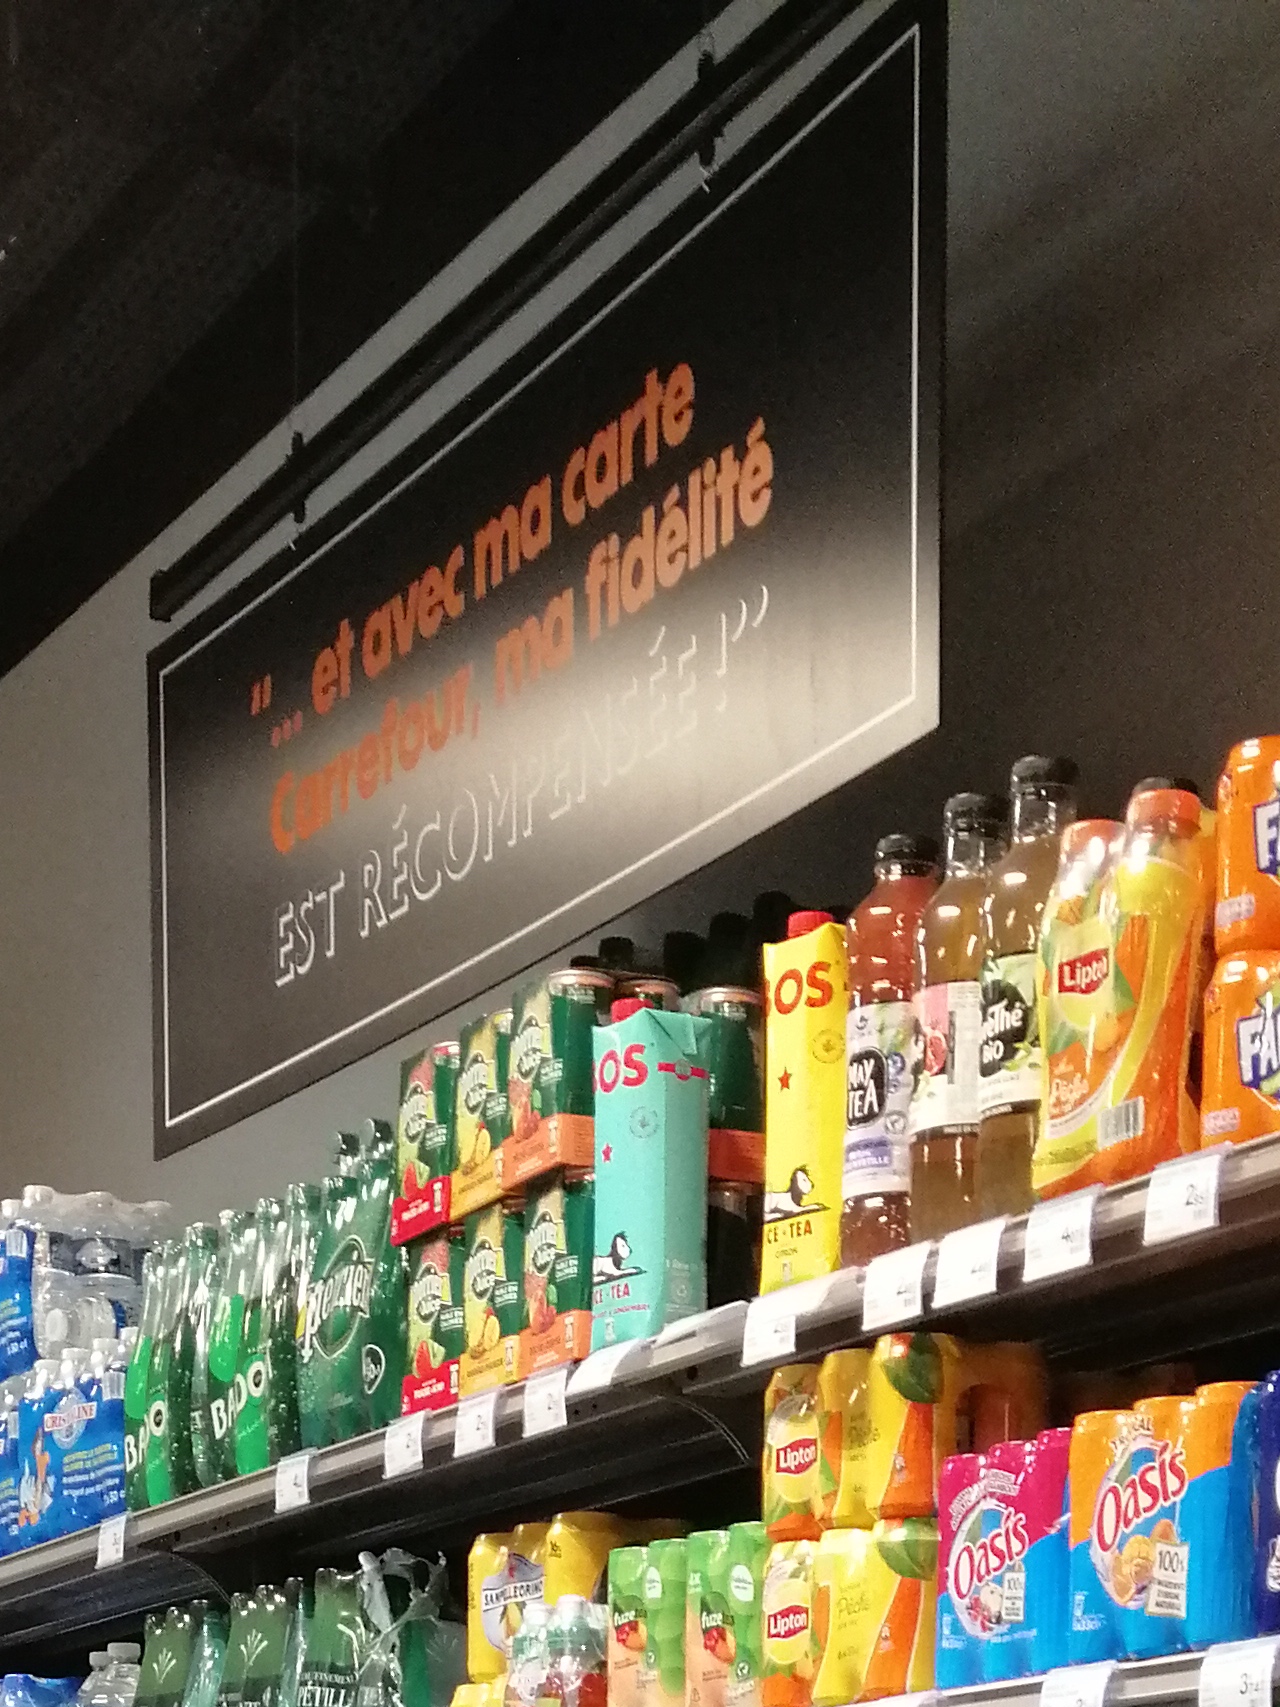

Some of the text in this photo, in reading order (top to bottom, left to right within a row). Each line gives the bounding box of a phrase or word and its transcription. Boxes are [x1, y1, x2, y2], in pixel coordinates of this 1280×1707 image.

[312, 618, 356, 717] et
[362, 545, 467, 680] avec
[473, 469, 553, 600] ma
[561, 361, 695, 525] carte
[495, 583, 577, 708] ma
[586, 417, 773, 639] fidélité
[275, 867, 345, 986] EST
[779, 1443, 816, 1470] Lipton
[1096, 1445, 1188, 1551] Oasis
[953, 1515, 1029, 1600] Oasis
[769, 1610, 808, 1635] Lipton
